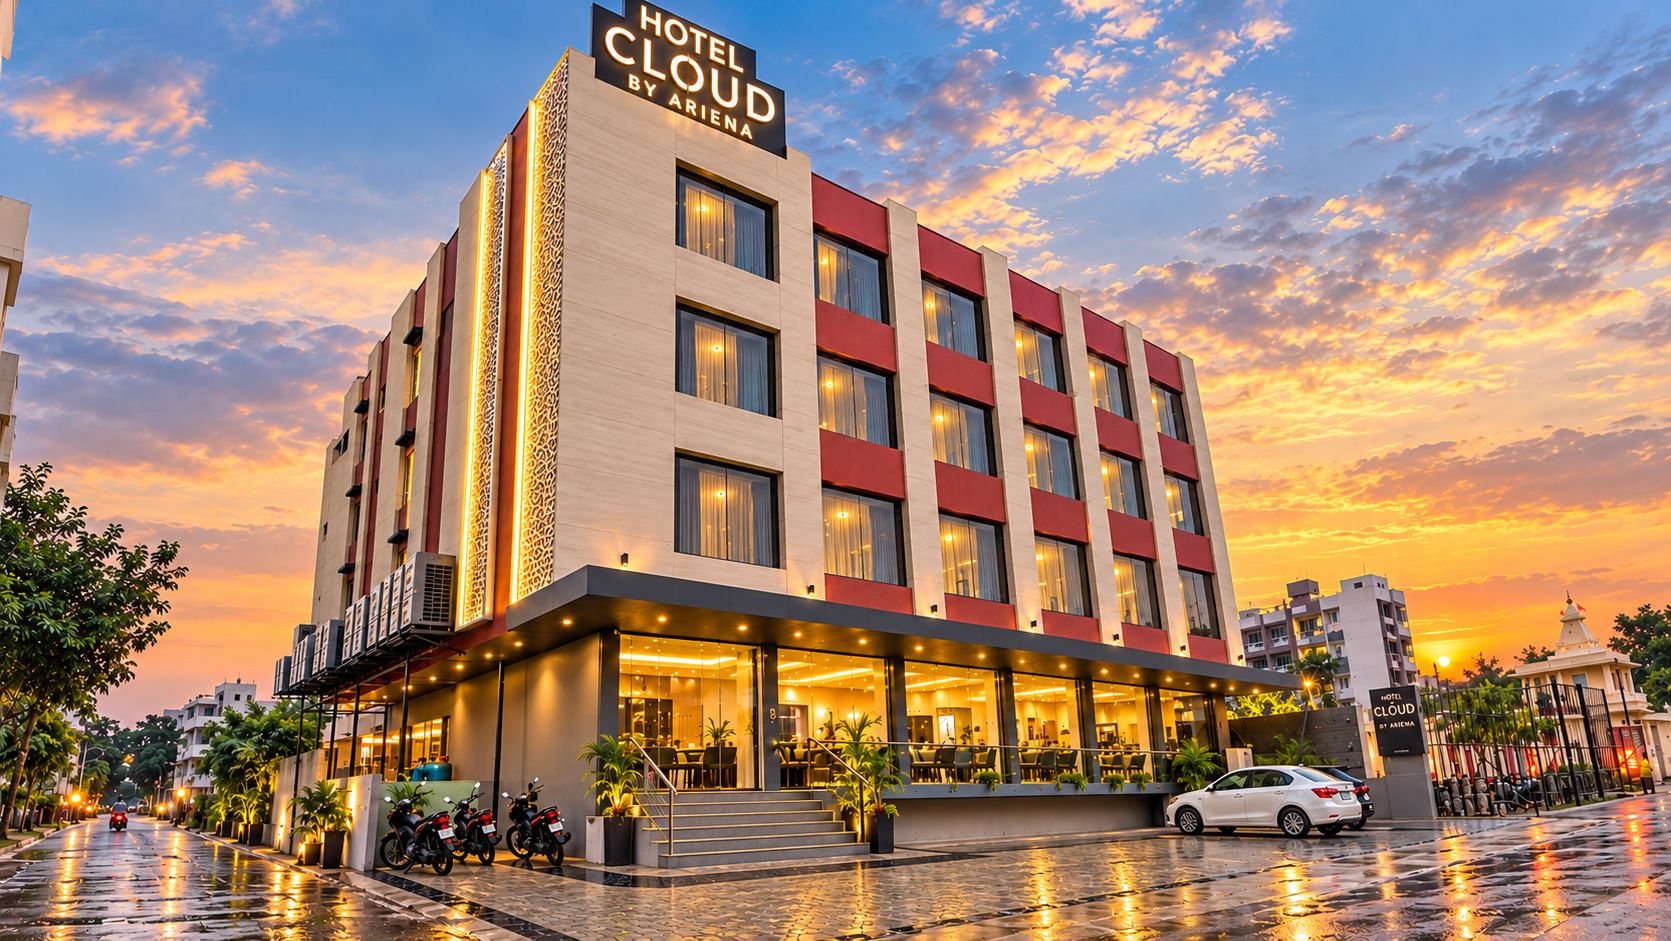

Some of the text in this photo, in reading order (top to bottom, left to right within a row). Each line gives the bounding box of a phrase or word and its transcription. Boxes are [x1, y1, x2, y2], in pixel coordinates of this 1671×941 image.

[640, 4, 744, 73] HOTEL
[604, 26, 776, 123] CLOUD
[628, 74, 753, 139] BY ARIENA
[1373, 703, 1415, 717] CLOUD
